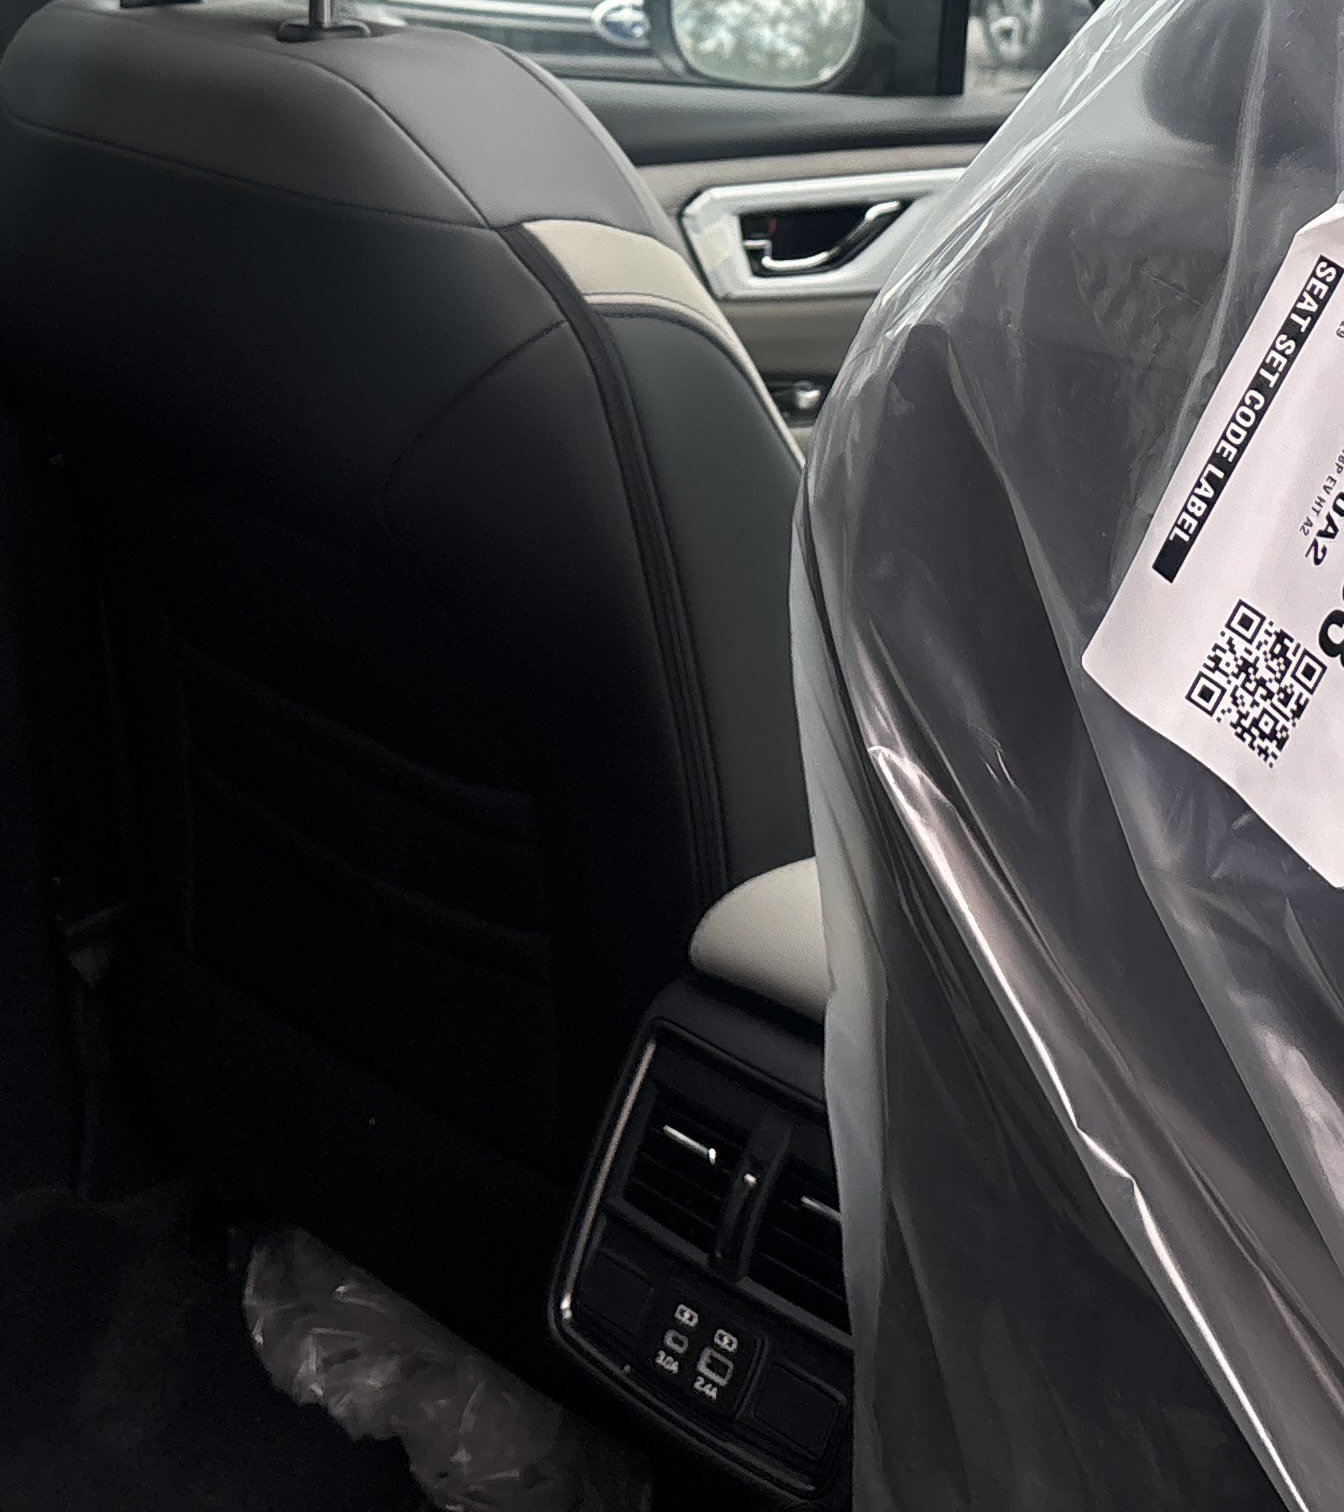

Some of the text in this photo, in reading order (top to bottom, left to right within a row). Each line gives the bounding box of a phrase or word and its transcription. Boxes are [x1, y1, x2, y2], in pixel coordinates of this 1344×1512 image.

[1168, 260, 1337, 542] SEAT SET CODE LABEL
[1322, 475, 1338, 495] EV
[1311, 495, 1327, 516] HT
[1299, 516, 1314, 536] A2
